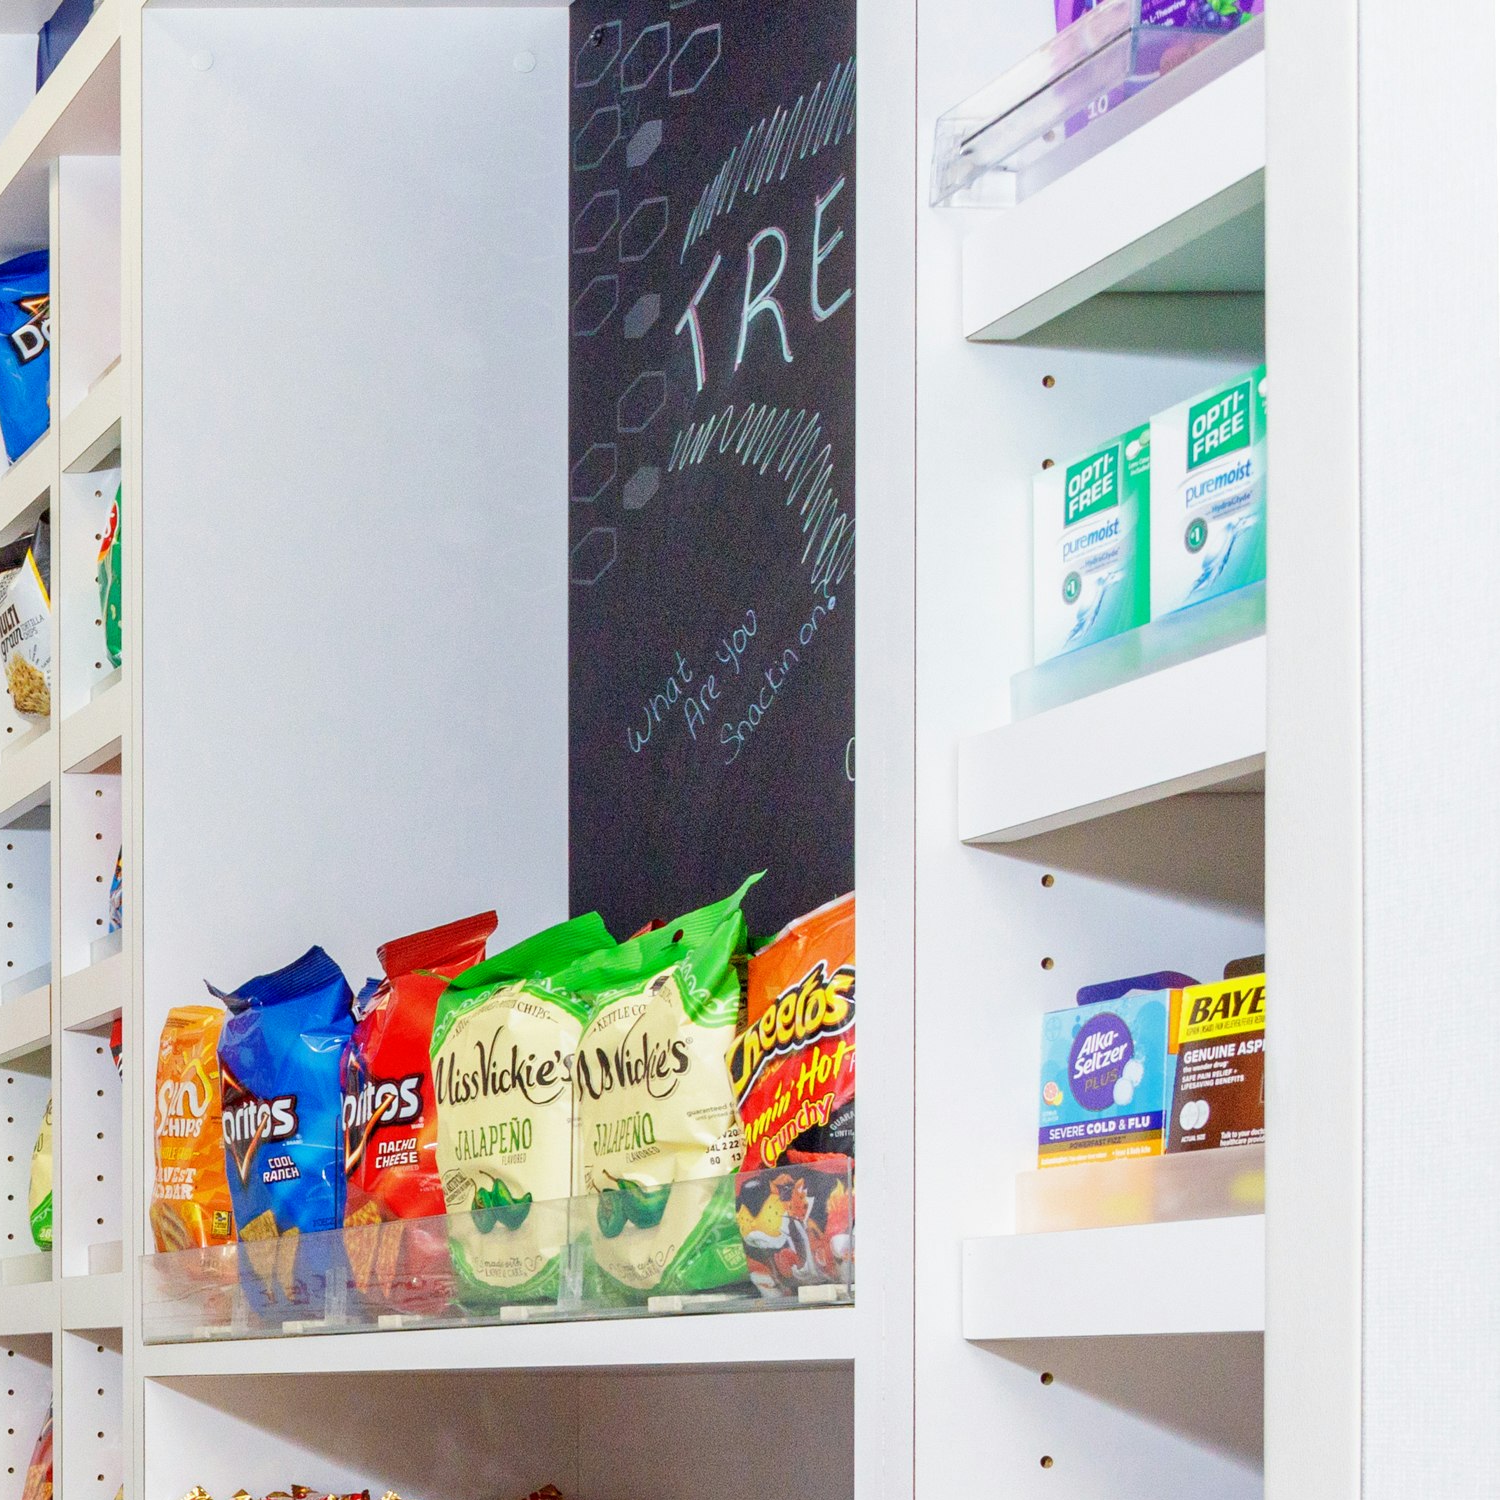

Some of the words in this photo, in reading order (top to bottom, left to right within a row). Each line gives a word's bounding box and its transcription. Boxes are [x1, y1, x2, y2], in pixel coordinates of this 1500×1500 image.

[1087, 94, 1109, 119] 10
[675, 174, 852, 393] TRE
[1192, 390, 1245, 440] OPTI-
[1192, 409, 1245, 463] FREE
[1067, 452, 1114, 498] OPTI-
[1186, 458, 1252, 508] puremoist
[1068, 475, 1114, 521] FREE
[1063, 518, 1119, 563] puremoist
[1, 623, 24, 664] grain
[685, 674, 721, 740] Are
[517, 1001, 549, 1020] CHIPS
[1188, 986, 1265, 1026] BAYE
[1073, 1043, 1128, 1079] Seltzer
[1077, 1030, 1119, 1058] Alka-
[1183, 1042, 1236, 1064] GENUINE
[797, 1041, 856, 1098] Hot
[1084, 1068, 1119, 1093] PLUS
[1181, 1073, 1197, 1083] SAFE
[1197, 1071, 1211, 1081] PAIN
[1212, 1068, 1233, 1079] RELIEF
[1181, 1079, 1214, 1091] LIFESAVING
[1215, 1074, 1245, 1086] BENEFITS
[222, 1098, 294, 1145] oritos
[341, 1077, 419, 1131] oritos
[686, 1104, 727, 1117] guaranteed
[378, 1138, 417, 1154] NACHO
[455, 1117, 532, 1161] JALAPEÑO
[594, 1112, 656, 1156] JALAPEÑO
[761, 1093, 835, 1168] Crunchy
[1049, 1125, 1085, 1140] SEVERE
[1086, 1120, 1116, 1135] COLD
[1118, 1119, 1126, 1131] &
[1128, 1115, 1150, 1129] FLU
[263, 1167, 300, 1183] RANCH
[268, 1155, 295, 1169] COOL
[375, 1151, 418, 1169] CHEESE
[502, 1153, 527, 1166] FLAVORED
